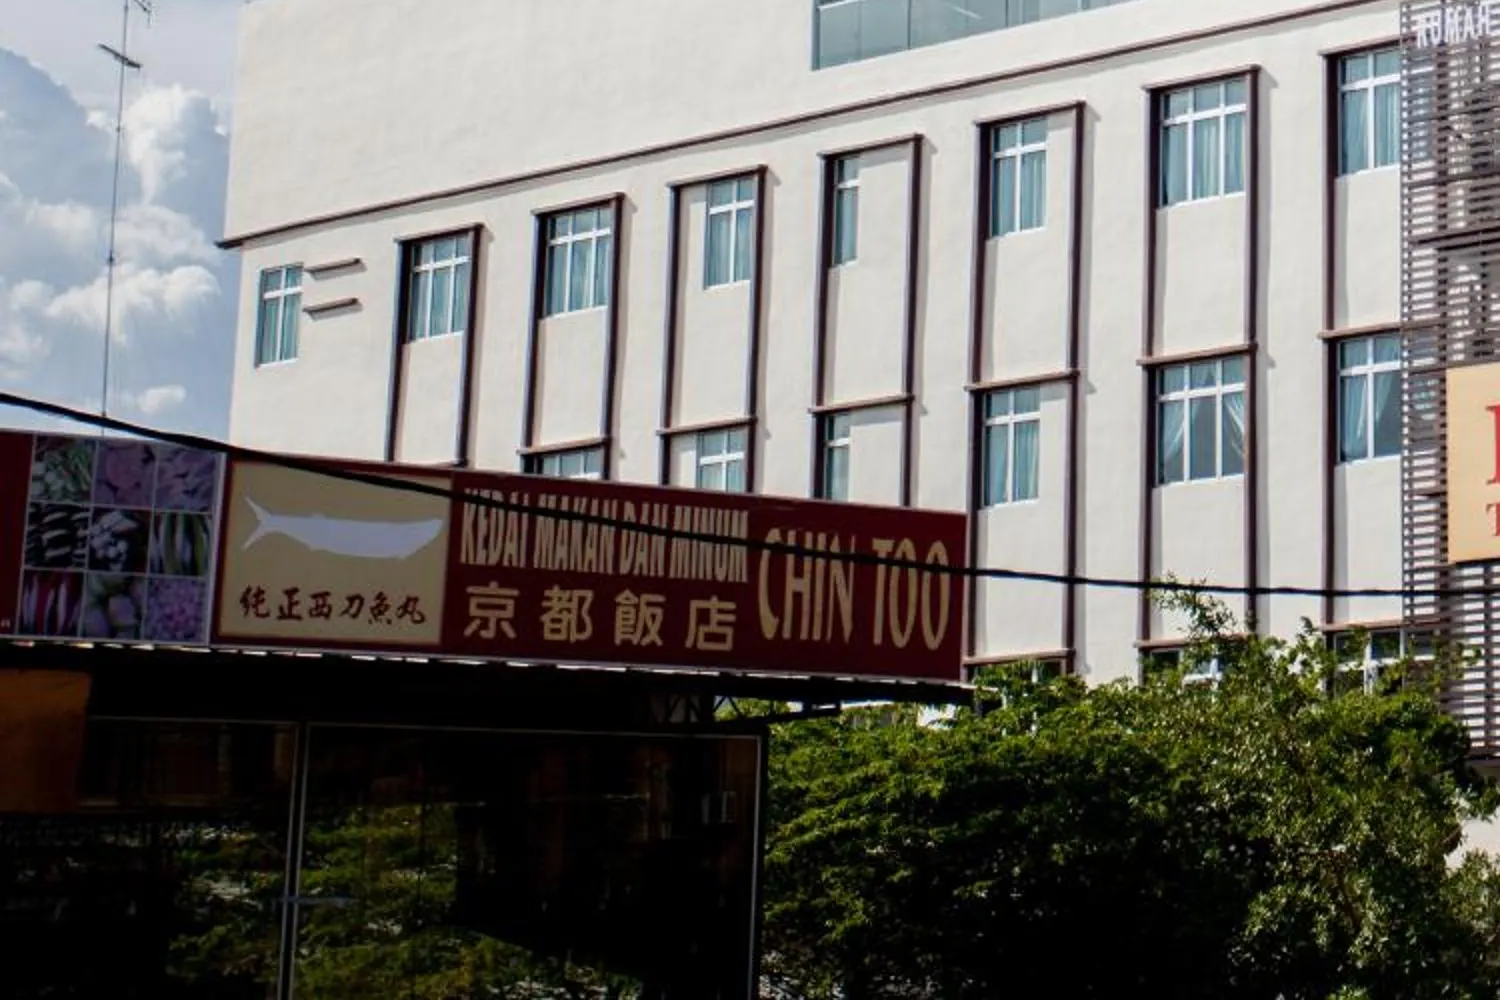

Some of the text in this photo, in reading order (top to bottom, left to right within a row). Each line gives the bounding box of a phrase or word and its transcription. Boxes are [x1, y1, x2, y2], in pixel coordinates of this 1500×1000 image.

[460, 487, 750, 584] KEDAI MAKAN DAN MINUM
[463, 580, 738, 651] 京都飯店
[758, 527, 950, 650] CHIN TOO
